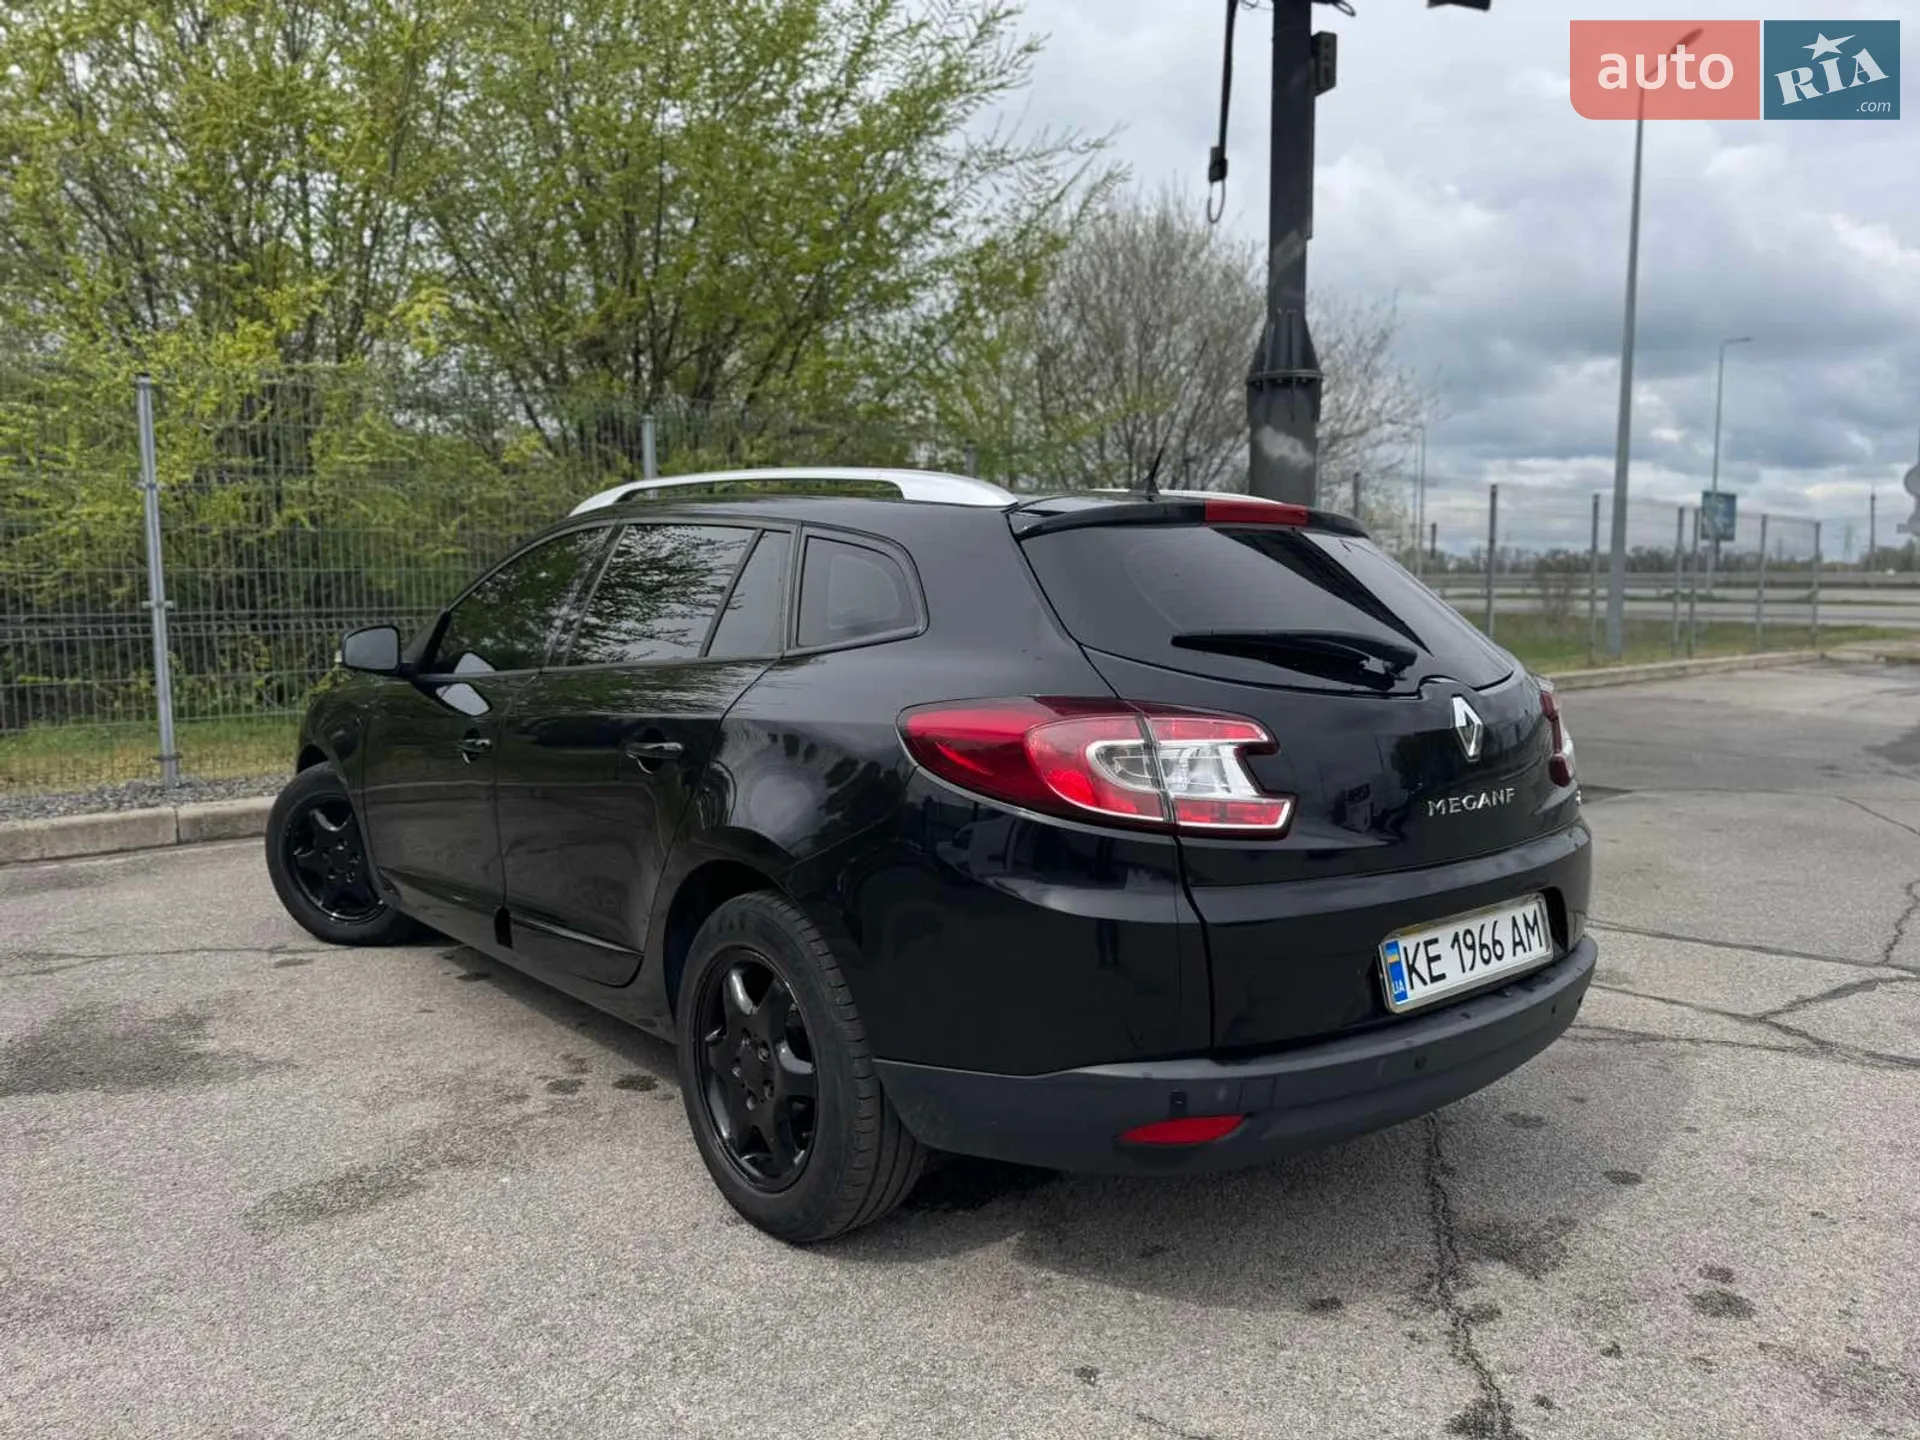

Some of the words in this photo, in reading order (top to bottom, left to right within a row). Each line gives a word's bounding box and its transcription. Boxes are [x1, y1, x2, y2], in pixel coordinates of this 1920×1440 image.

[1403, 938, 1446, 990] KE
[1450, 920, 1505, 973] 1966
[1512, 909, 1543, 957] AM
